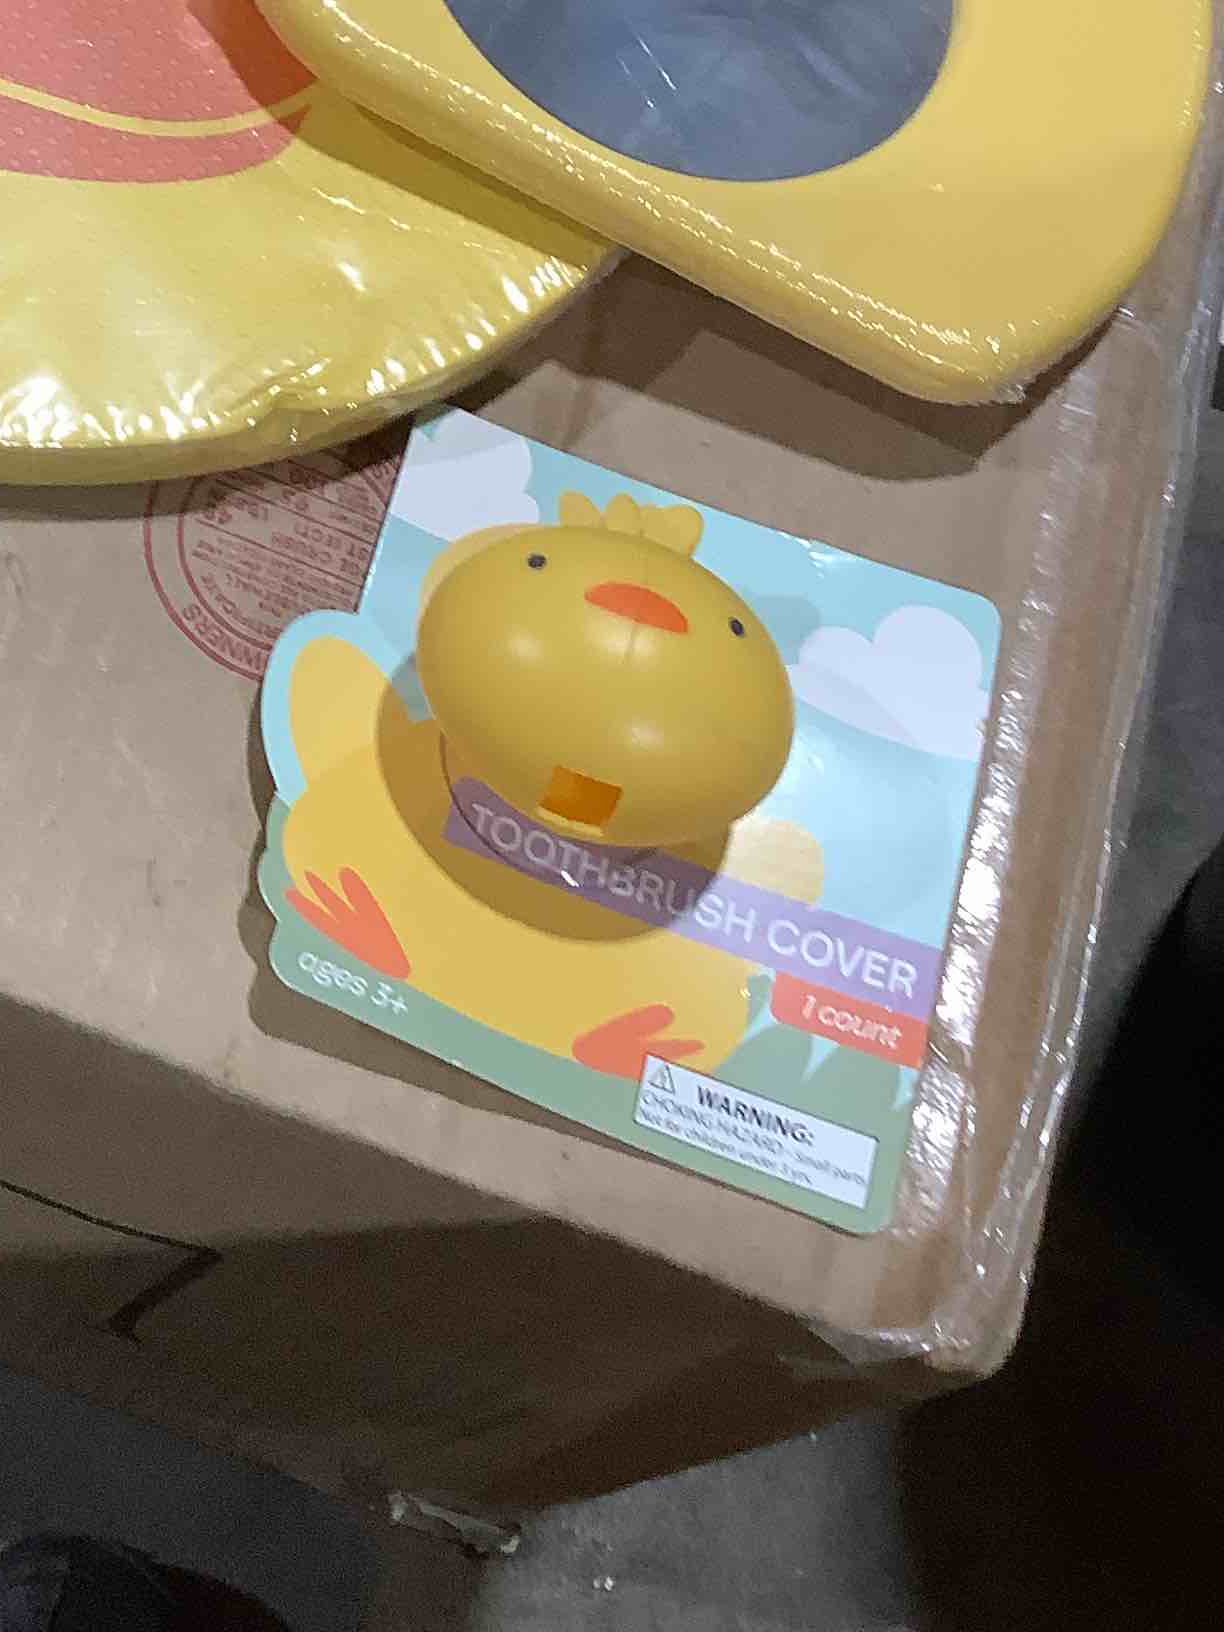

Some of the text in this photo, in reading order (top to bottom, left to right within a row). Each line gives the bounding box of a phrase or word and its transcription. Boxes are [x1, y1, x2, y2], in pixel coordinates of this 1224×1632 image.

[471, 803, 918, 998] TOOTHBRUSH COVER
[296, 949, 411, 1016] ages 3+
[802, 993, 905, 1050] 1 count
[695, 1083, 817, 1147] WARNING:
